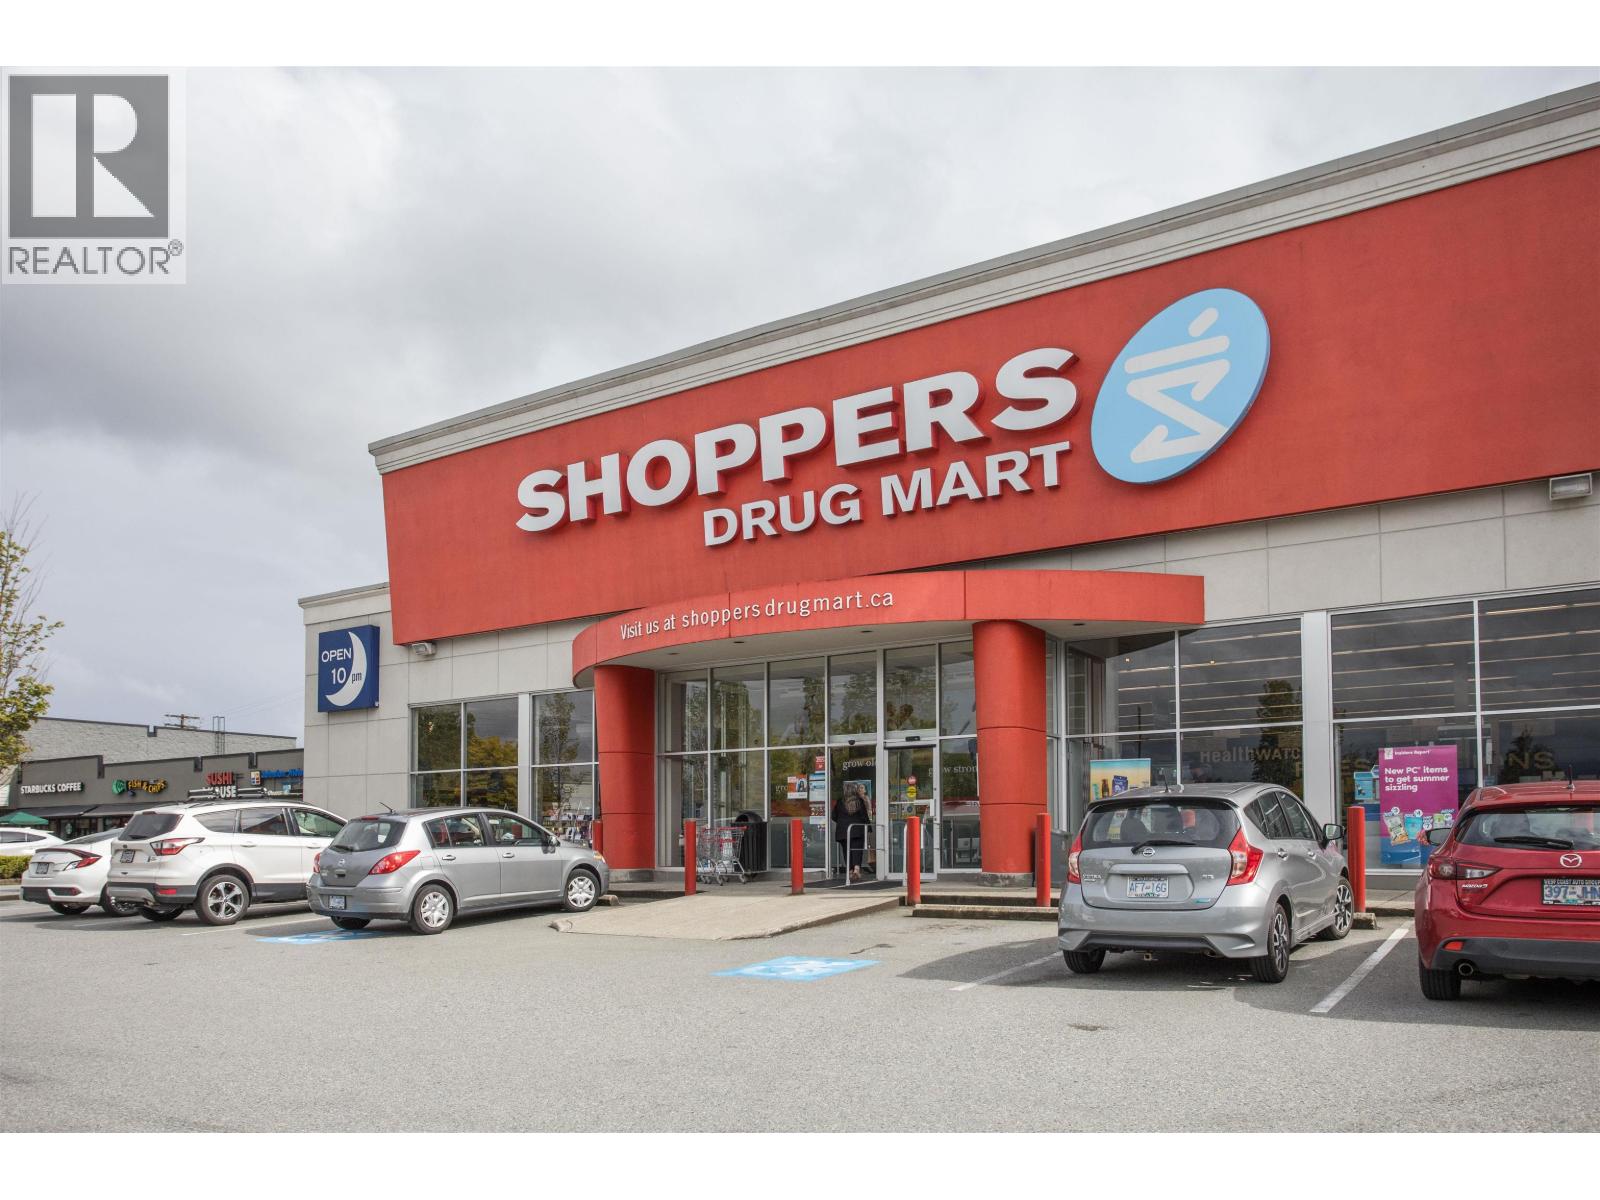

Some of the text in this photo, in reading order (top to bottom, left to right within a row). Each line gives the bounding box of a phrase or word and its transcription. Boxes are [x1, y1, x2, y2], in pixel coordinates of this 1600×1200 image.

[515, 346, 1079, 532] SHOPPERS
[703, 440, 1071, 547] DRUG MART
[619, 621, 643, 640] Visit
[645, 620, 660, 634] us
[663, 613, 677, 631] at
[321, 647, 353, 663] OPEN
[331, 667, 363, 685] 10 pm
[842, 760, 864, 771] grow
[1384, 767, 1404, 775] New
[1423, 765, 1449, 773] items
[205, 771, 234, 785] SUSHI
[1396, 775, 1411, 785] get
[20, 782, 82, 794] STARBUCKS COFFEE
[127, 780, 142, 790] FISH
[148, 781, 166, 793] CHIPS
[1384, 784, 1418, 792] sizzling
